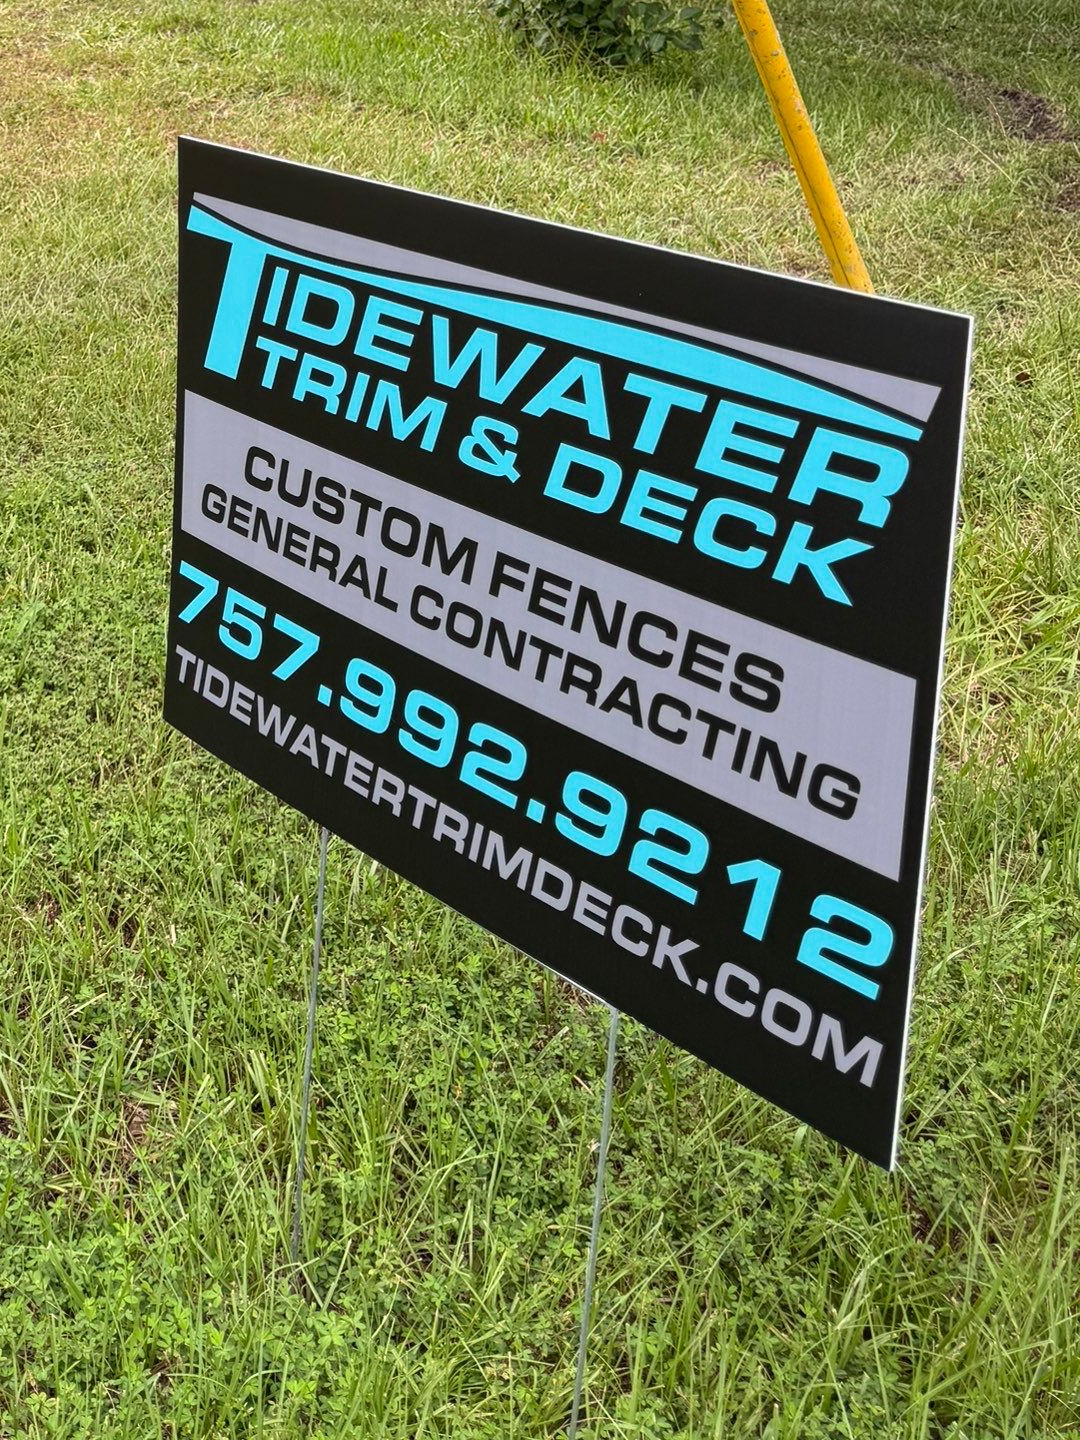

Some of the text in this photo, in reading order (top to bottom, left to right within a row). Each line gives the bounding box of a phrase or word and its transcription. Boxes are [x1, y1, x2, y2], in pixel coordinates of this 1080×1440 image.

[186, 206, 910, 529] TIDEWATER
[255, 336, 873, 607] TRIM & DECK
[201, 483, 861, 821] GENERAL CONTRACTING
[244, 445, 785, 713] CUSTOM FENCES
[175, 644, 884, 1088] TIDEWATERTRIMDECK.COM
[178, 561, 895, 1001] 757.992.9212
